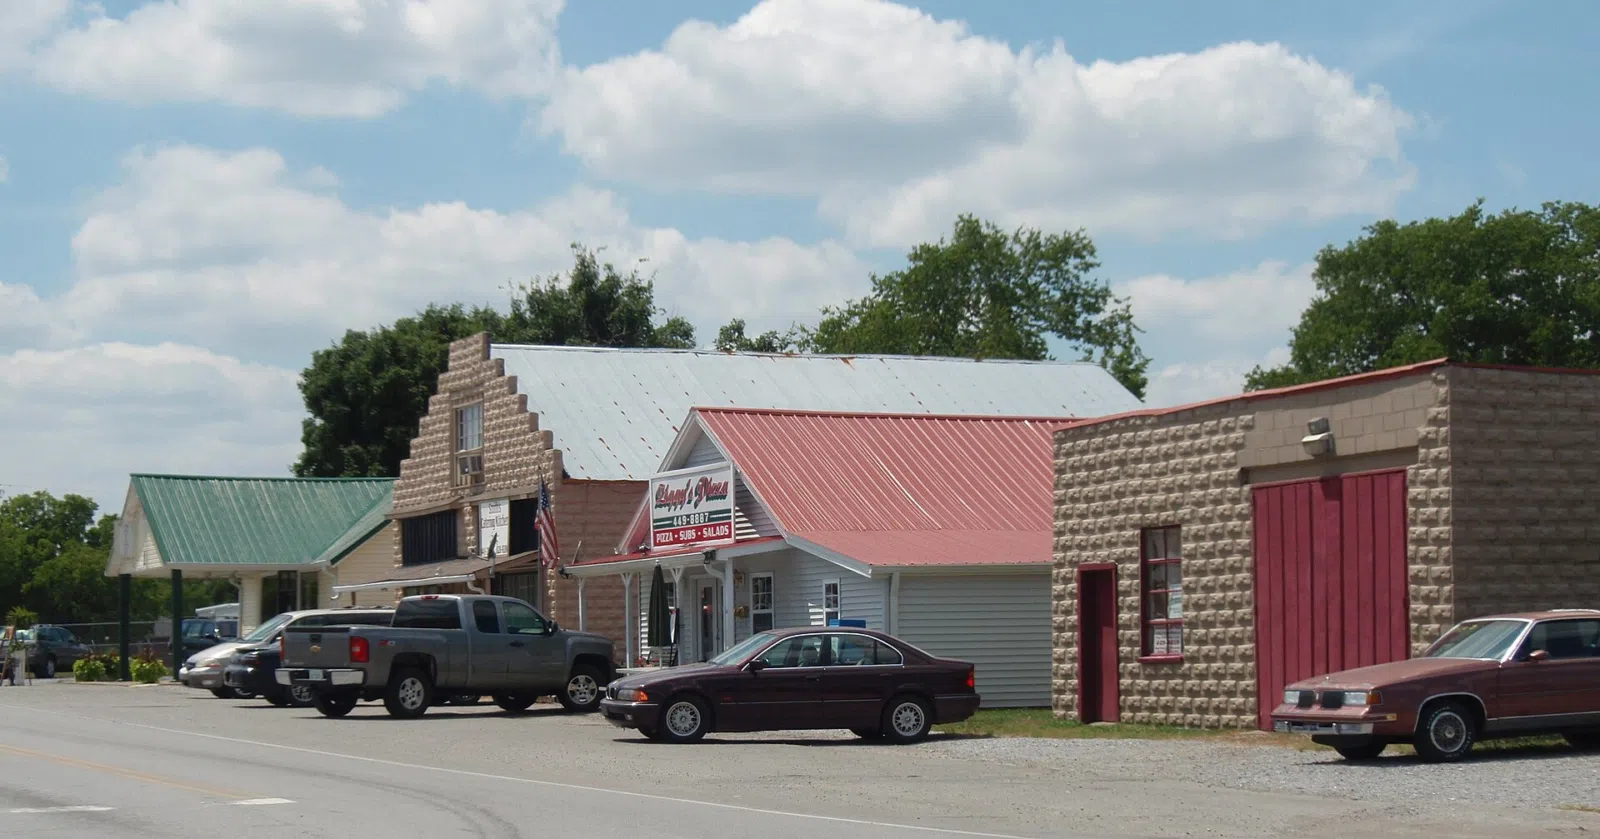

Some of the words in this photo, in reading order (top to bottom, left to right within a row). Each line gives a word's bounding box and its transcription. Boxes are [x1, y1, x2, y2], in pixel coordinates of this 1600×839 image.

[694, 476, 729, 509] Pizza
[656, 532, 673, 543] PIZZA
[679, 529, 696, 541] SUBS
[702, 525, 729, 537] SALADS
